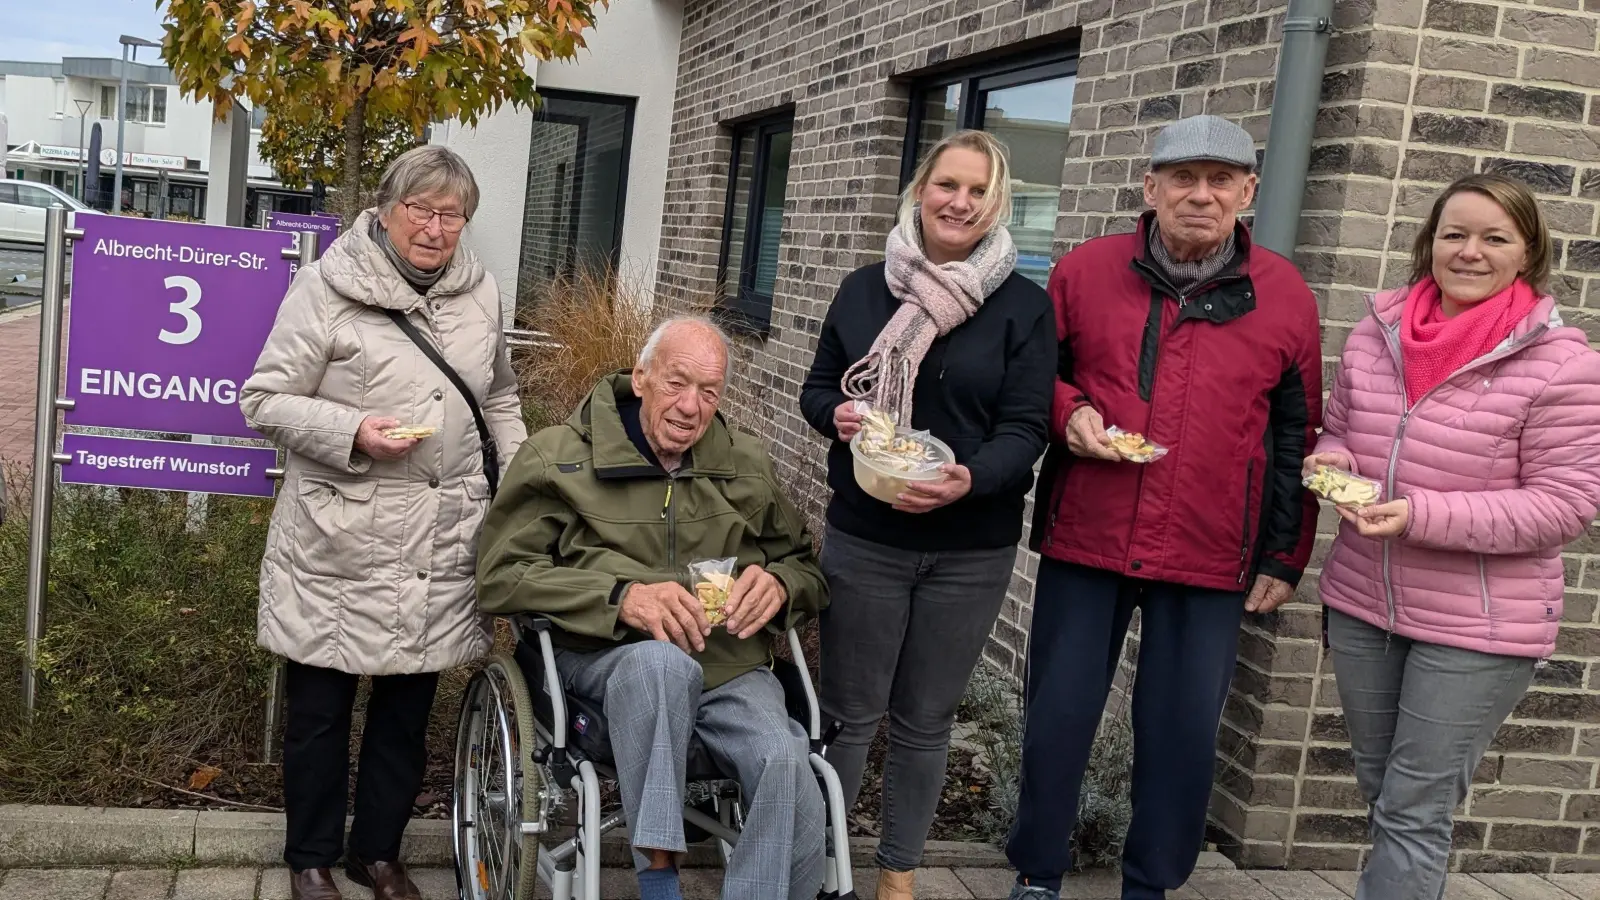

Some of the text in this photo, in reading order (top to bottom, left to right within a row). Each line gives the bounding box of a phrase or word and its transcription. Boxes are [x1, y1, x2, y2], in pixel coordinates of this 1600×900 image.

[276, 219, 332, 232] Albrecht-Dürer-Str.
[94, 238, 269, 271] Albrecht-Dürer-Str.
[157, 275, 203, 345] 3
[80, 368, 237, 405] EINGANG
[76, 450, 250, 477] Tagestreff Wunstorf
